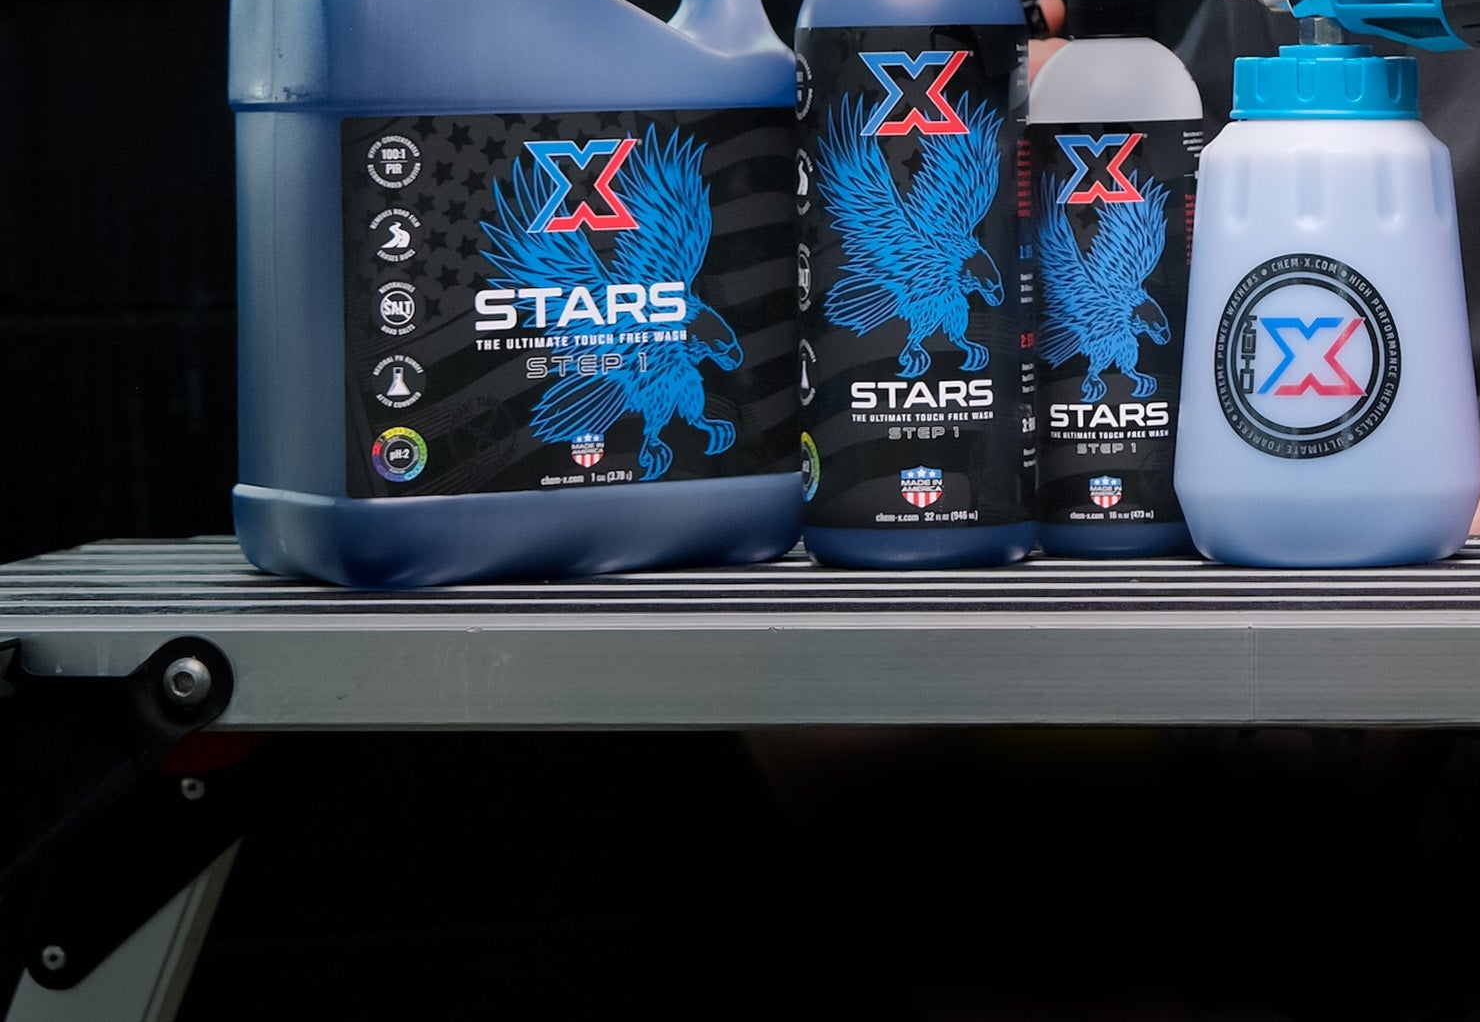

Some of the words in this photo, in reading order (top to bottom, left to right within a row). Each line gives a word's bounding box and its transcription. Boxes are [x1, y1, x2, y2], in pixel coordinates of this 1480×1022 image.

[1271, 257, 1338, 274] CHEM-X.COM
[1227, 274, 1259, 316] WASHERS
[1349, 274, 1372, 297] HIGH
[383, 301, 412, 315] SALT
[475, 282, 686, 331] STARS
[476, 339, 500, 351] THE
[506, 336, 569, 349] ULTIMATE
[575, 333, 613, 347] TOUCH
[619, 332, 649, 344] FREE
[653, 330, 687, 342] WASH
[1217, 320, 1230, 359] POWER
[1371, 297, 1398, 379] PERFORMANCE
[526, 353, 623, 379] STEP
[639, 352, 649, 373] 1
[851, 379, 994, 409] STARS
[1217, 366, 1234, 414] EXTREME
[852, 414, 866, 422] THE
[870, 413, 912, 422] ULTIMATE
[915, 413, 945, 421] TOUCH
[948, 412, 969, 421] FREE
[971, 411, 994, 420] WASH
[1050, 402, 1169, 428] STARS
[1355, 383, 1395, 437] CHEMICALS
[888, 426, 945, 440] STEP
[953, 426, 960, 438] 1
[1062, 431, 1096, 439] ULTIMATE
[1099, 431, 1124, 439] TOUCH
[1127, 430, 1146, 438] FREE
[1148, 429, 1169, 437] WASH
[1236, 418, 1281, 453] FOAMERS
[1076, 442, 1124, 454] STEP
[1131, 442, 1137, 453] 1
[1286, 437, 1345, 455] ULTIMATE
[924, 512, 934, 521] 32
